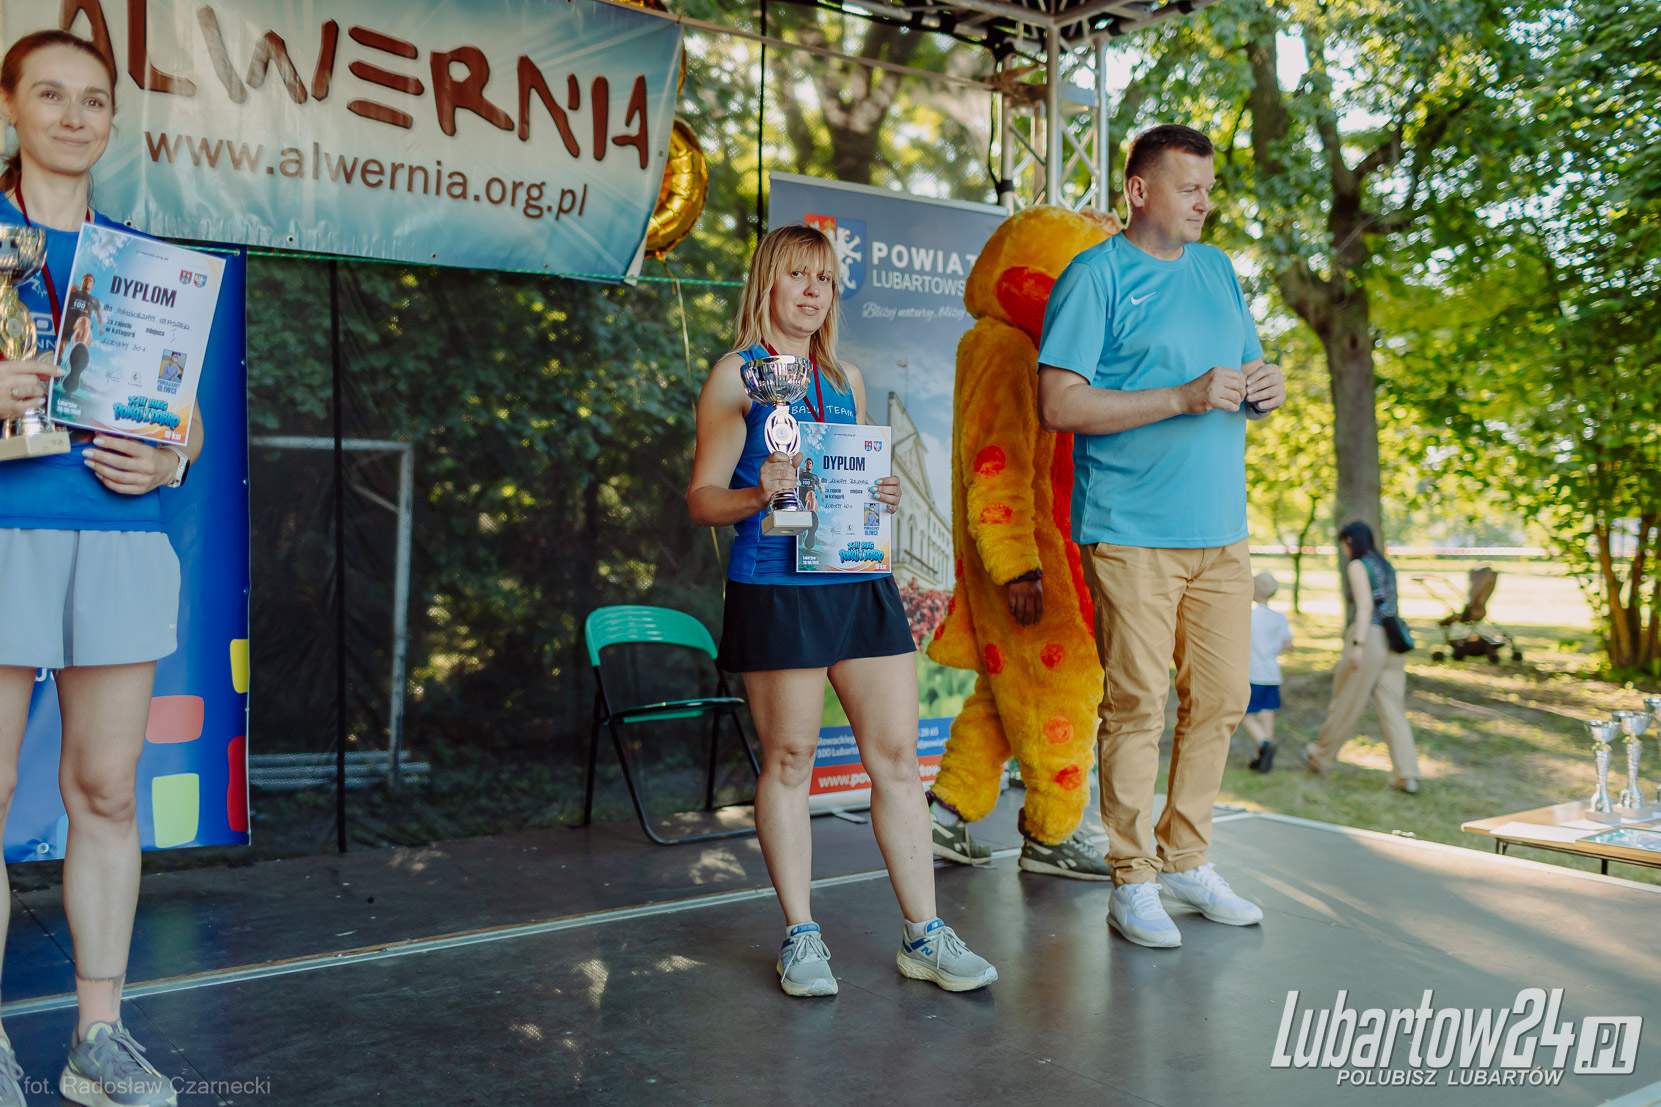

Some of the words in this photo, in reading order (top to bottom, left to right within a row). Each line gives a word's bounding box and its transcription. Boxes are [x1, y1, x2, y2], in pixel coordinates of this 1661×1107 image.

[144, 131, 588, 221] www.alwernia.org.pl
[110, 275, 177, 308] DYPLOM
[823, 455, 866, 472] DYPLOM
